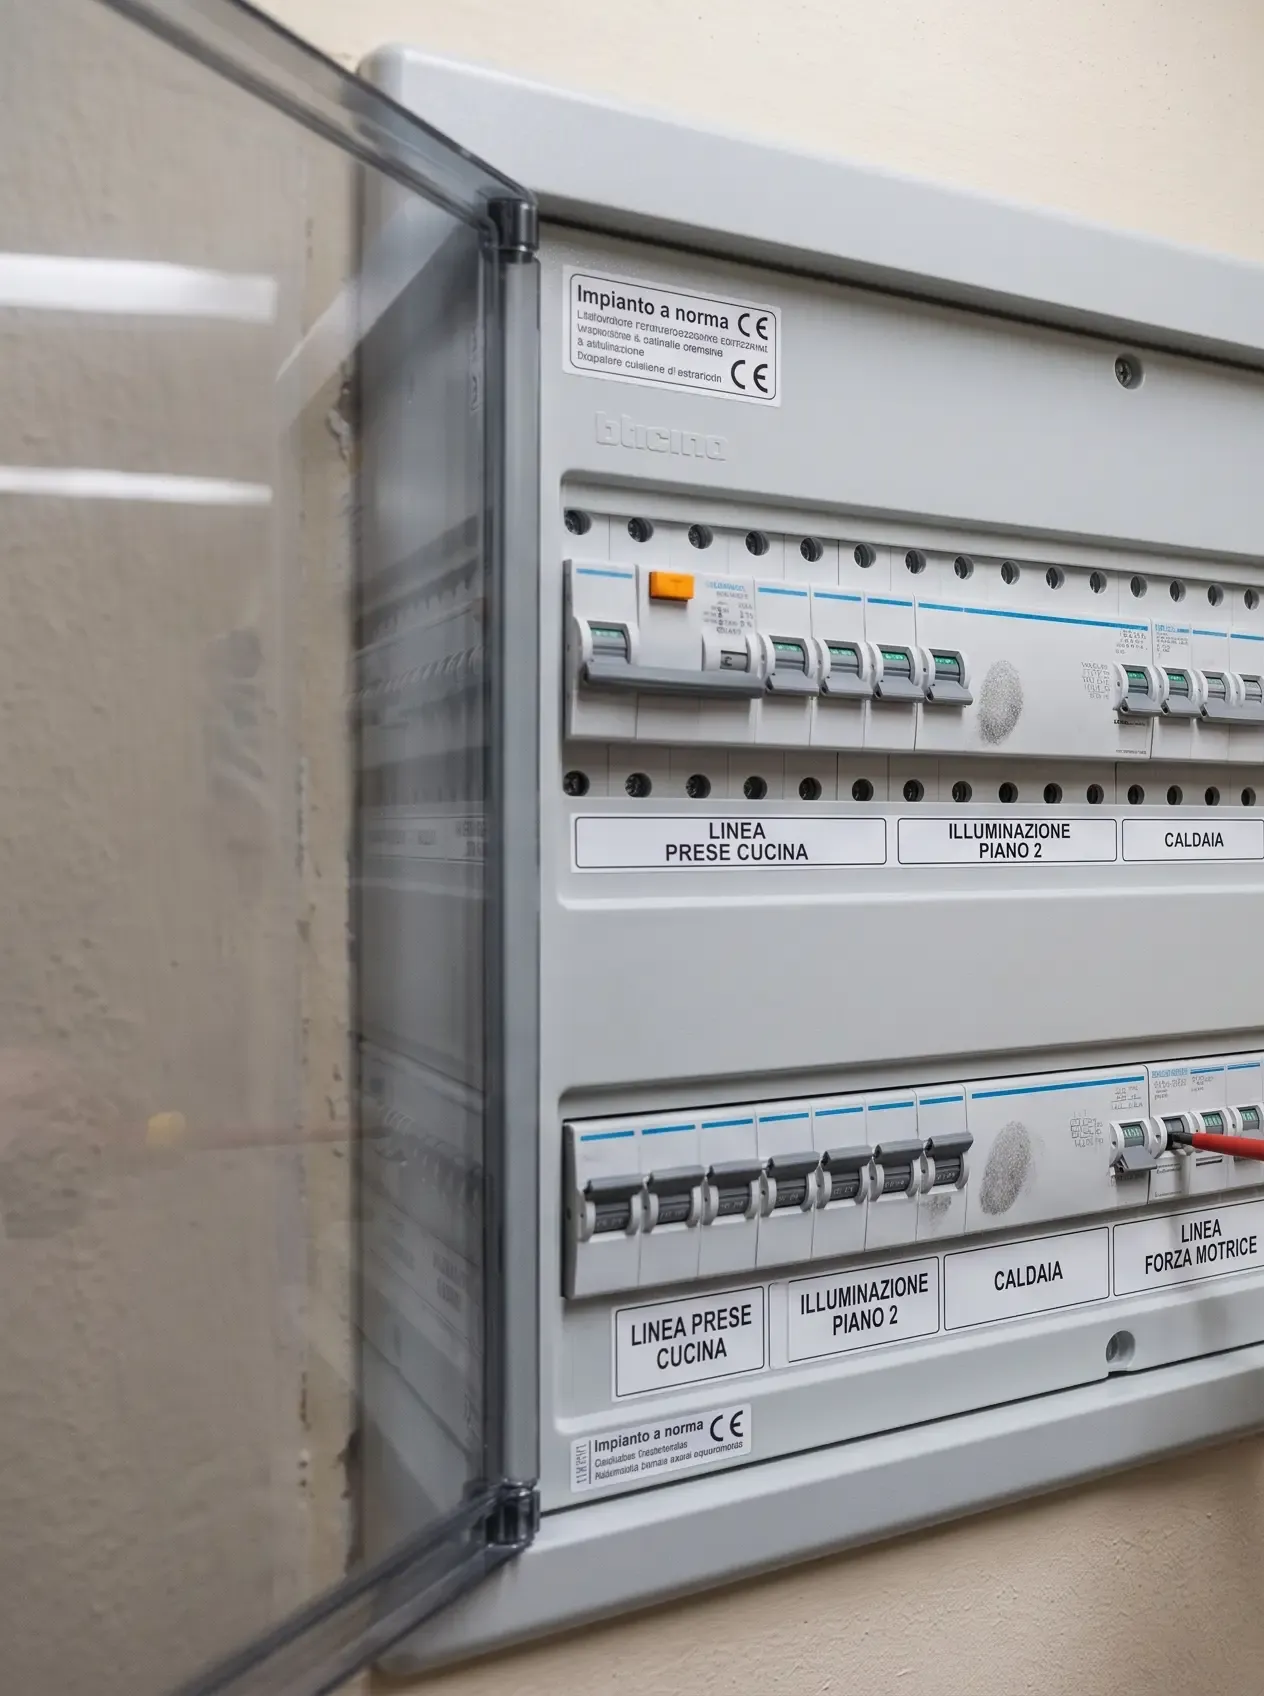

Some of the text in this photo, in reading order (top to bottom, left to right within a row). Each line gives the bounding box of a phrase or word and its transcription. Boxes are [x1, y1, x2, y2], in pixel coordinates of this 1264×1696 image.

[577, 285, 654, 315] Impianto
[660, 305, 670, 319] a
[675, 307, 729, 330] norma
[737, 312, 769, 341] CE
[730, 359, 769, 394] CE
[709, 822, 766, 840] LINEA
[949, 822, 1071, 840] ILLUMINAZIONE
[1164, 832, 1225, 848] CALDAIA
[665, 843, 809, 862] PRESE CUCINA
[979, 842, 1042, 859] PIANO 2
[1181, 1218, 1222, 1244] LINEA
[1144, 1235, 1258, 1275] FORZA MOTRICE
[993, 1260, 1064, 1291] CALDAIA
[800, 1273, 929, 1315] ILLUMINAZIONE
[631, 1304, 752, 1347] LINEA PRESE
[832, 1305, 898, 1336] PIANO 2
[656, 1337, 728, 1370] CUCINA
[594, 1420, 704, 1453] Impianto a norma
[709, 1409, 744, 1442] CE
